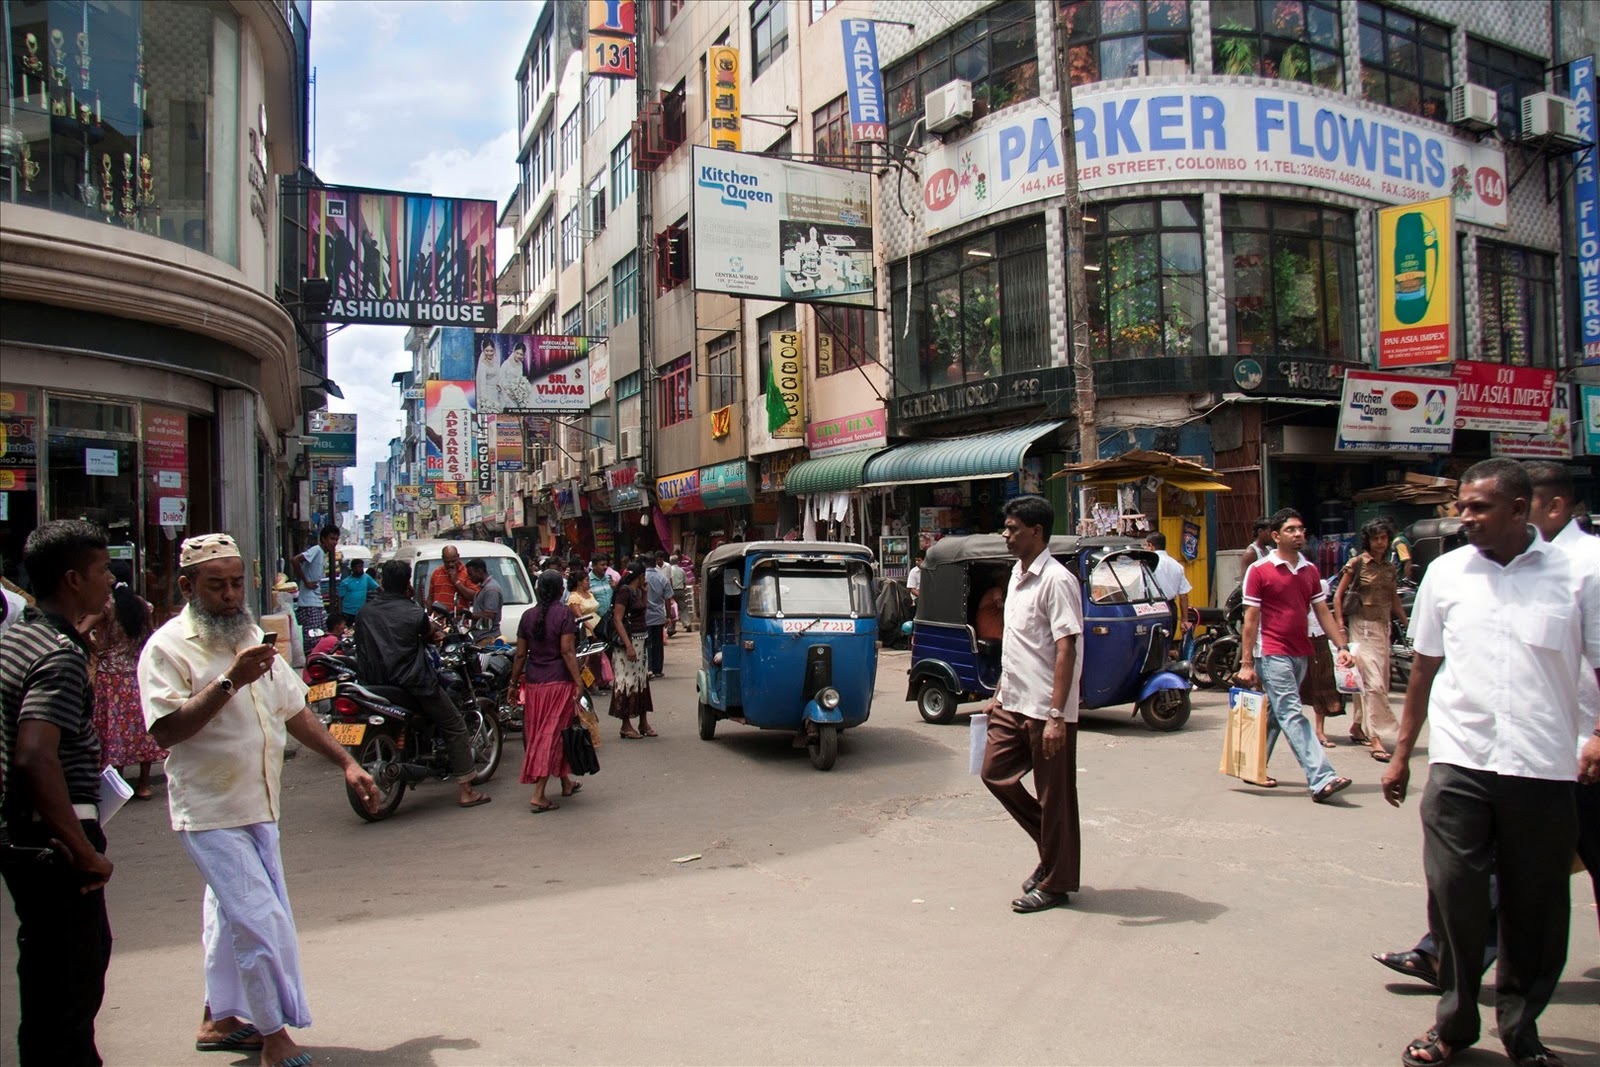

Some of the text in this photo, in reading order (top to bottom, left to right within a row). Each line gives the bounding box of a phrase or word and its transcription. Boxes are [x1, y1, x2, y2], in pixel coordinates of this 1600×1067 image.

[595, 42, 631, 71] 131
[850, 20, 880, 122] PARKER
[857, 125, 885, 140] 144
[999, 95, 1447, 188] PARKER FLOWERS
[1175, 157, 1247, 171] COLOMBO
[702, 166, 758, 187] Kitchen
[726, 184, 773, 203] Queen
[928, 173, 956, 206] 144
[1478, 173, 1502, 200] 144
[1579, 200, 1600, 337] FLOWERS
[417, 302, 486, 322] HOUSE
[1384, 332, 1445, 346] PAN ASIA IMPEX
[548, 374, 566, 383] SRI
[1011, 378, 1040, 397] 139
[536, 384, 585, 395] VIJAYAS
[1352, 392, 1382, 404] Kitchen
[1479, 385, 1510, 404] ASIA
[1512, 387, 1551, 407] IMPEX
[901, 382, 999, 419] CENTRAL WORLD
[1363, 404, 1388, 416] Queen
[854, 429, 882, 441] Accessories
[1409, 426, 1451, 435] CENTRAL WORLD
[445, 410, 460, 473] APSARAS
[478, 446, 490, 489] GUCCI
[658, 475, 698, 500] SRIYANI
[162, 511, 183, 523] Dialog
[395, 520, 406, 528] 79
[373, 703, 406, 716] PLATINA
[337, 734, 357, 744] 6838
[341, 725, 354, 734] VF
